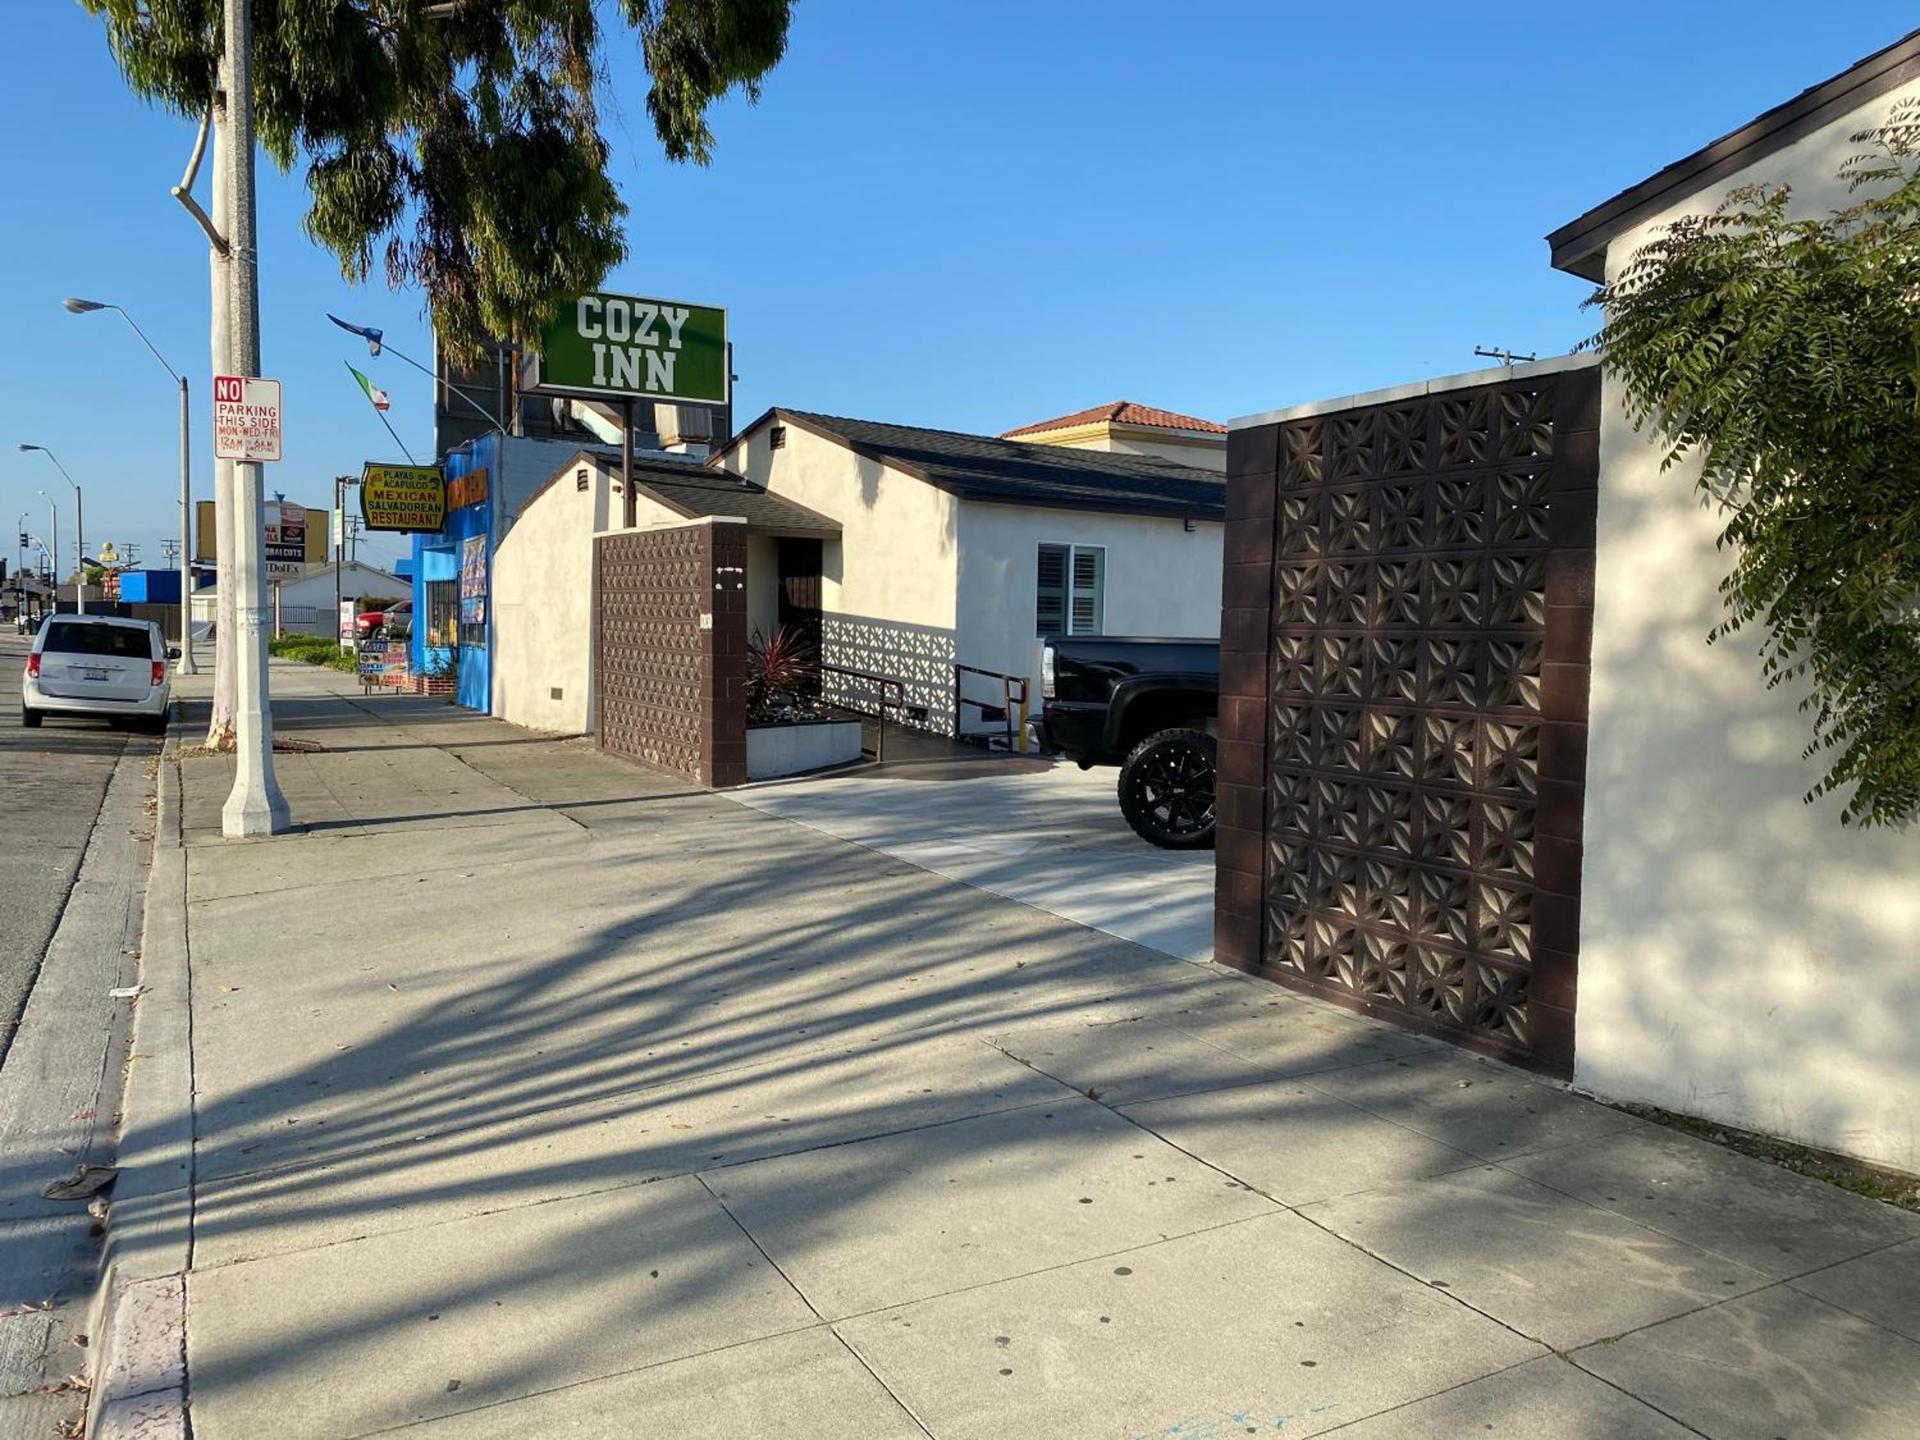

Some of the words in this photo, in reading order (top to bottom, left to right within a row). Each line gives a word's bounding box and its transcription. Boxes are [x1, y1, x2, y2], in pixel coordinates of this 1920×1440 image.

[577, 296, 690, 349] COZY
[592, 343, 676, 393] INN
[217, 380, 240, 400] NO
[219, 404, 276, 417] PARKING
[219, 416, 245, 427] THIS
[251, 417, 277, 428] SIDE
[384, 471, 414, 480] PLAYAS
[384, 480, 428, 489] ACAPULCO
[374, 490, 436, 502] MEXICAN
[368, 500, 441, 512] SALVADOREAN
[372, 512, 438, 525] RESTAURANT
